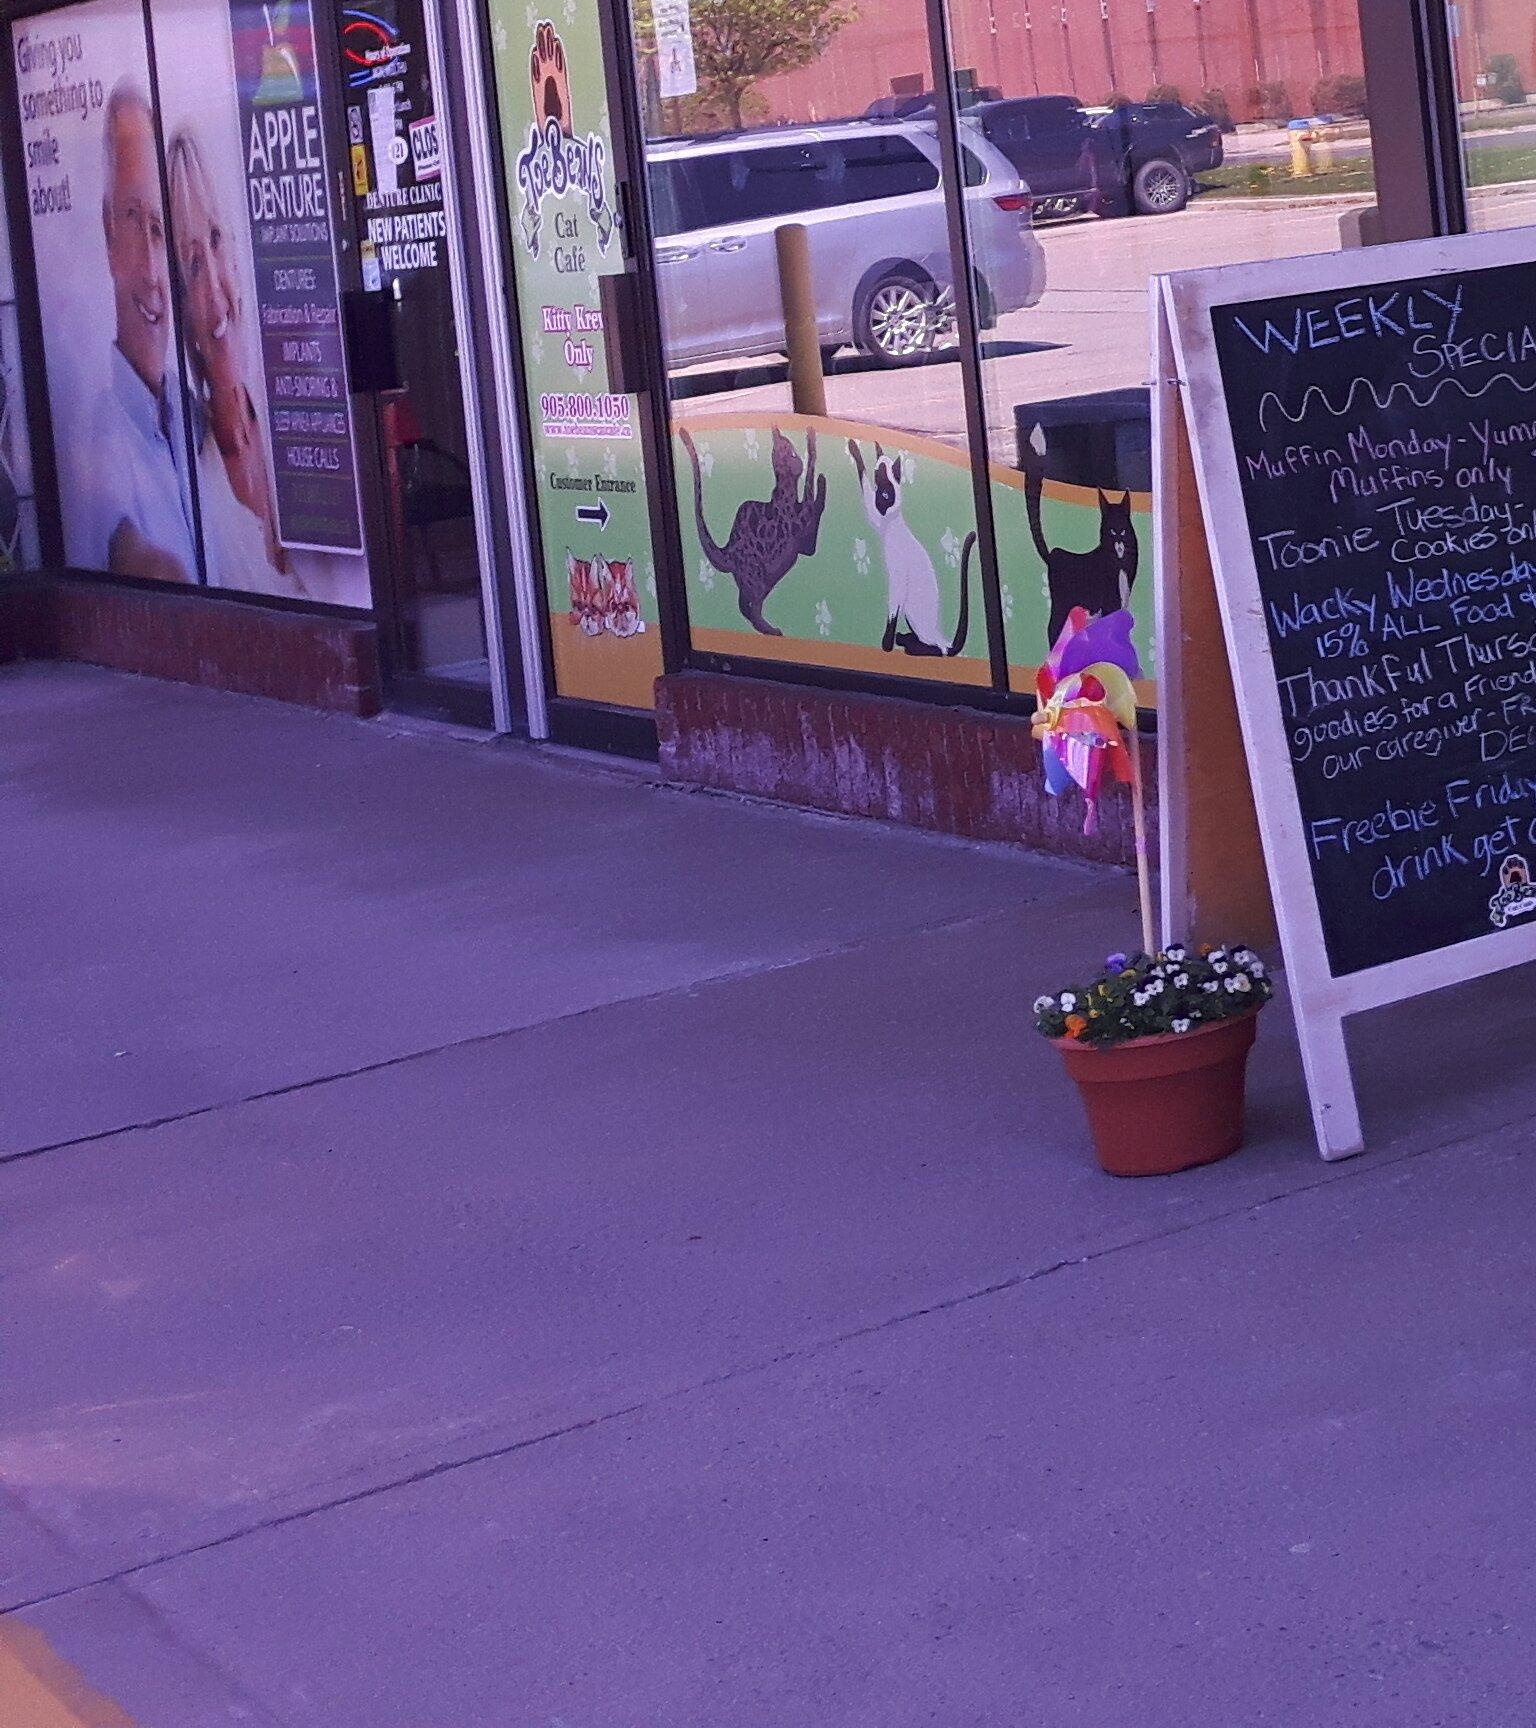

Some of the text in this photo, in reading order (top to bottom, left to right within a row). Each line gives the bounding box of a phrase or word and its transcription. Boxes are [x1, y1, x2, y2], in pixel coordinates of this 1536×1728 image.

[58, 33, 83, 74] you
[249, 105, 321, 173] APPLE
[412, 123, 440, 162] CLOS
[249, 173, 325, 221] DENTURE
[409, 182, 442, 206] CLINIC
[367, 210, 446, 244] NEW PATIENTS
[554, 210, 580, 240] Cat
[381, 241, 438, 271] WELCOME
[553, 245, 587, 274] Café
[541, 303, 572, 338] Kitty
[1233, 283, 1464, 356] WEEKLY
[563, 337, 595, 373] Only
[541, 393, 630, 420] 905.800.1050
[549, 471, 637, 493] Customer Entrance
[1329, 465, 1445, 505] Muffins
[1456, 456, 1514, 496] only
[1258, 525, 1380, 572] Toonie
[1390, 523, 1500, 564] Cookies
[1270, 587, 1378, 639] Wacky
[1316, 621, 1371, 660] 15%
[1381, 611, 1442, 643] ALL
[1450, 592, 1514, 628] Food
[1293, 704, 1398, 763] goodies
[1400, 695, 1434, 724] for
[1437, 691, 1459, 711] a
[1309, 798, 1440, 862] Freebie
[1371, 832, 1469, 902] drink
[1473, 814, 1520, 878] get
